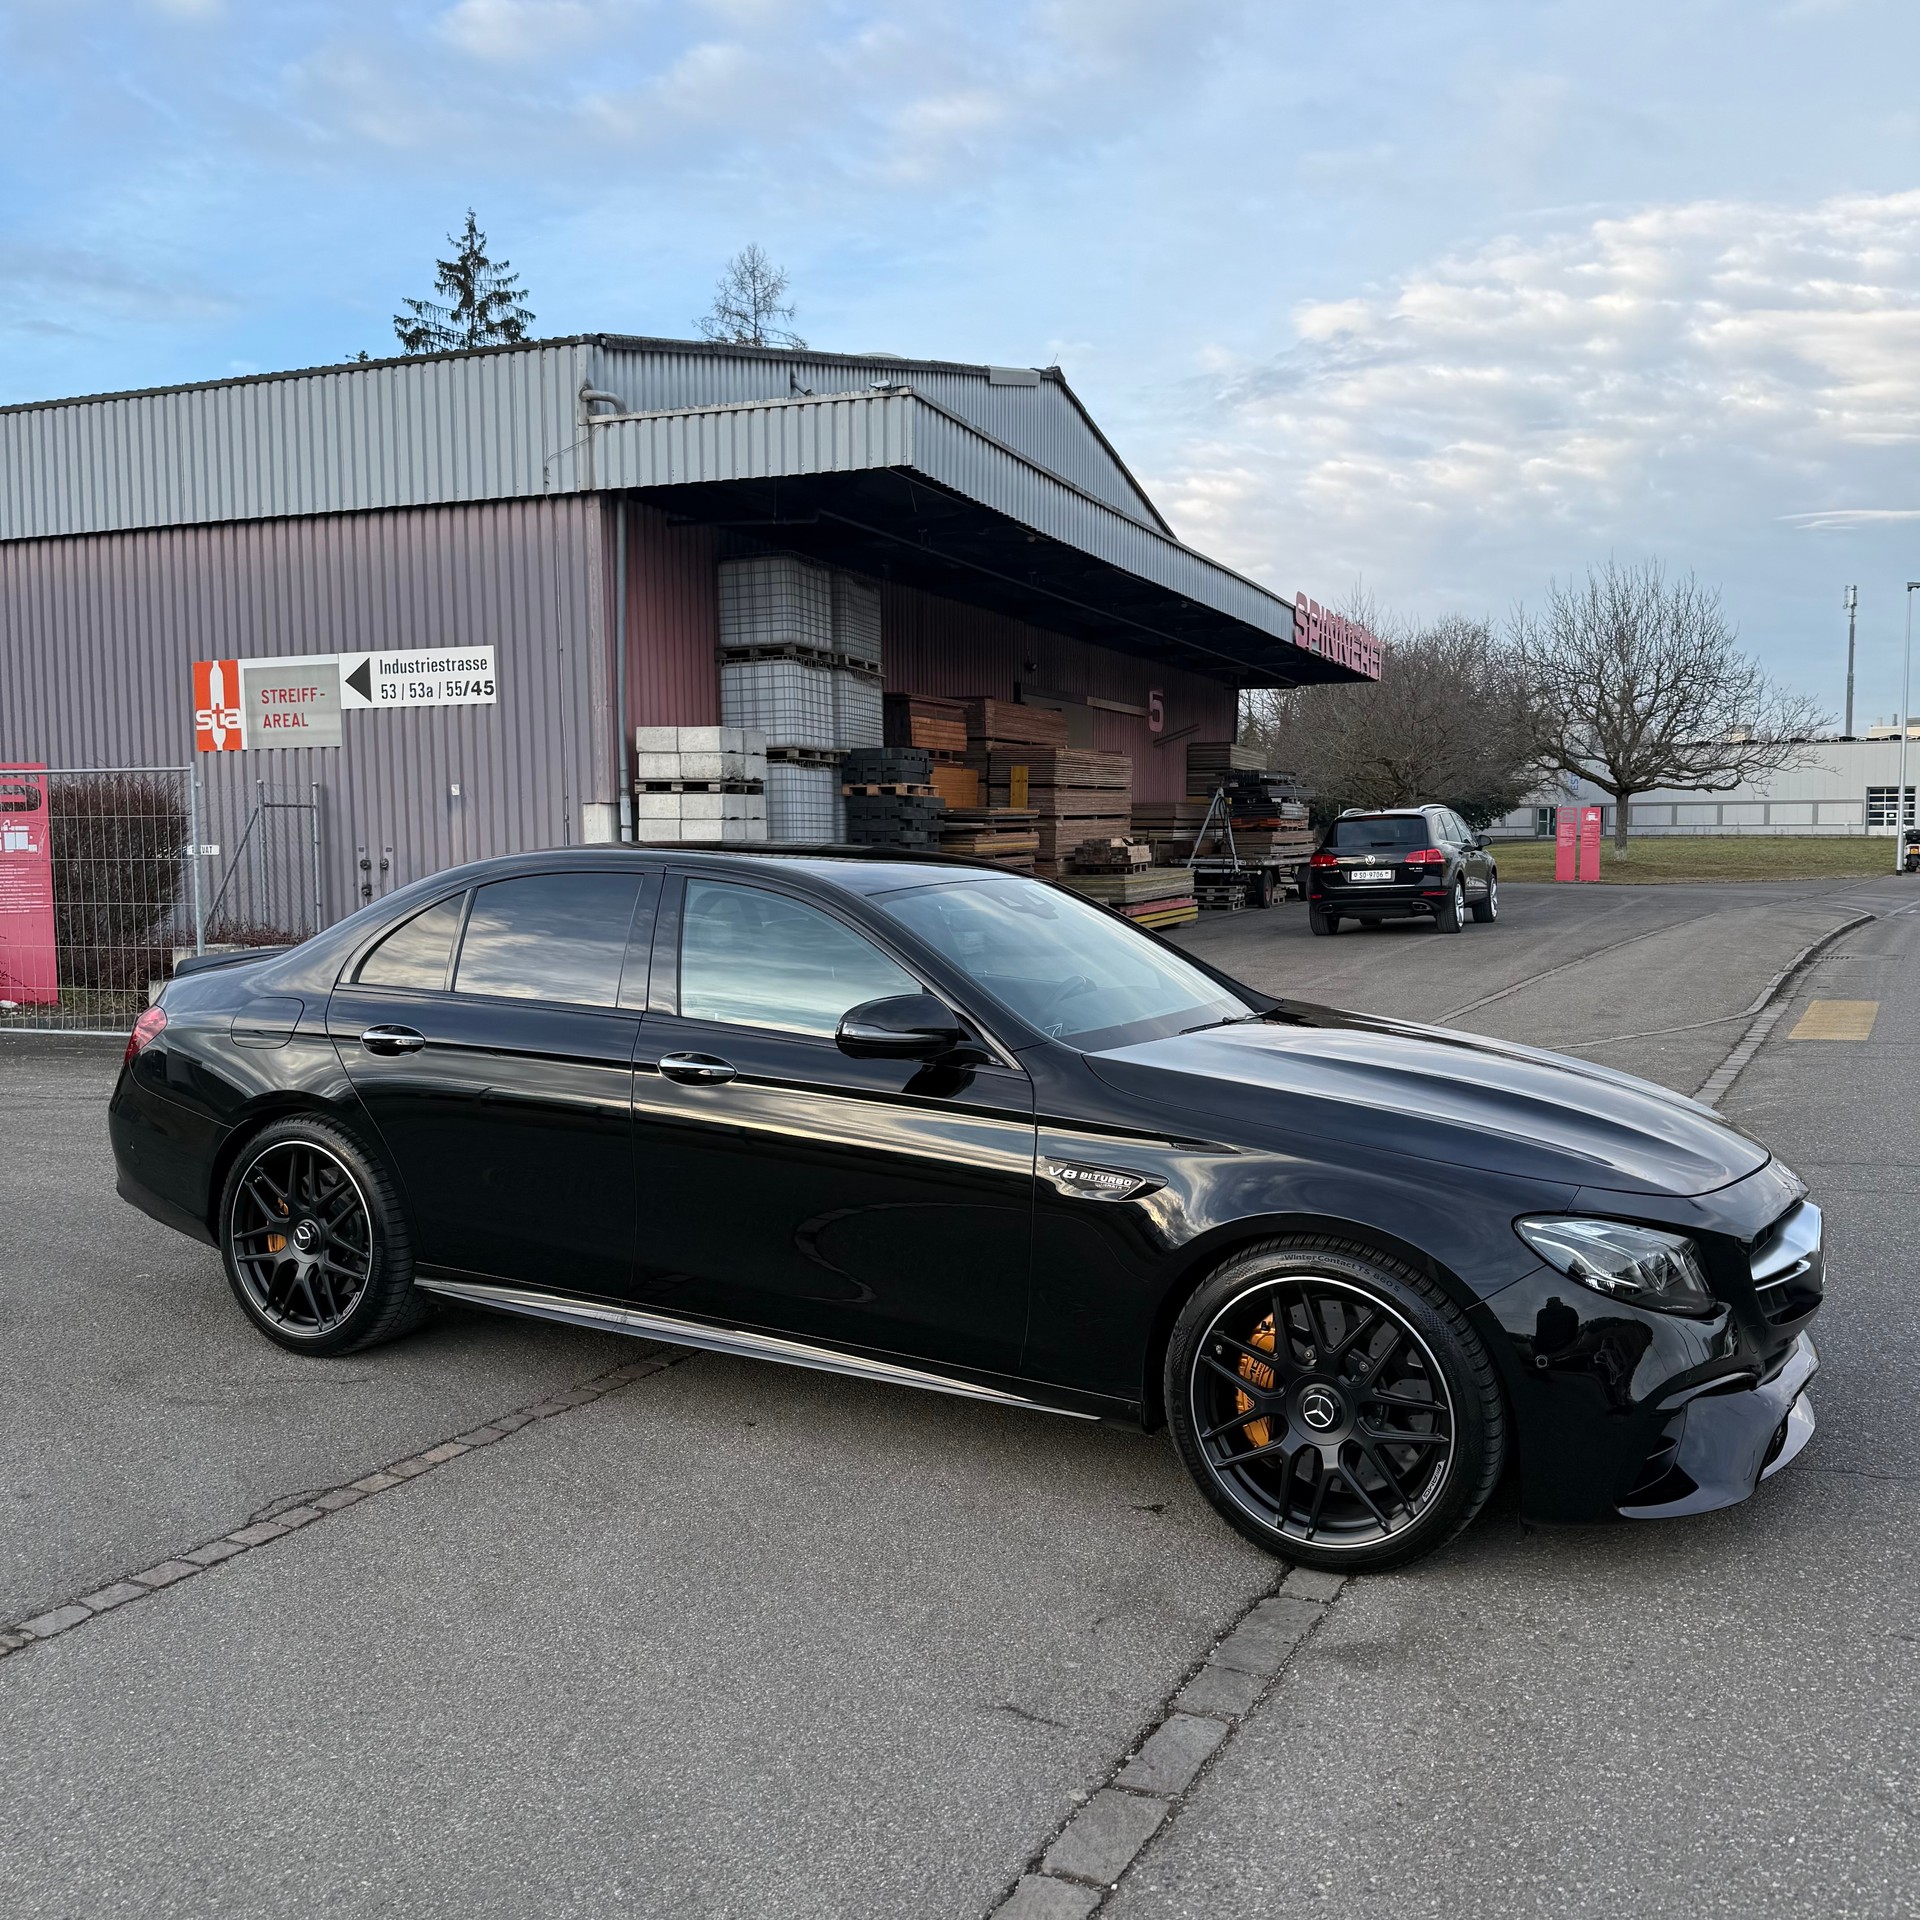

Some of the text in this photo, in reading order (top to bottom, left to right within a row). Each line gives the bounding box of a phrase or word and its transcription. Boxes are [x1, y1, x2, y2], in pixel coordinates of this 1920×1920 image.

[380, 657, 488, 675] Industriestrasse
[261, 687, 326, 704] STREIFF-
[381, 683, 397, 699] 53
[409, 682, 434, 698] 53a
[1148, 688, 1164, 733] 5
[263, 712, 309, 728] AREAL
[1048, 1166, 1132, 1186] V8 BITURBO
[1358, 1265, 1370, 1275] TS
